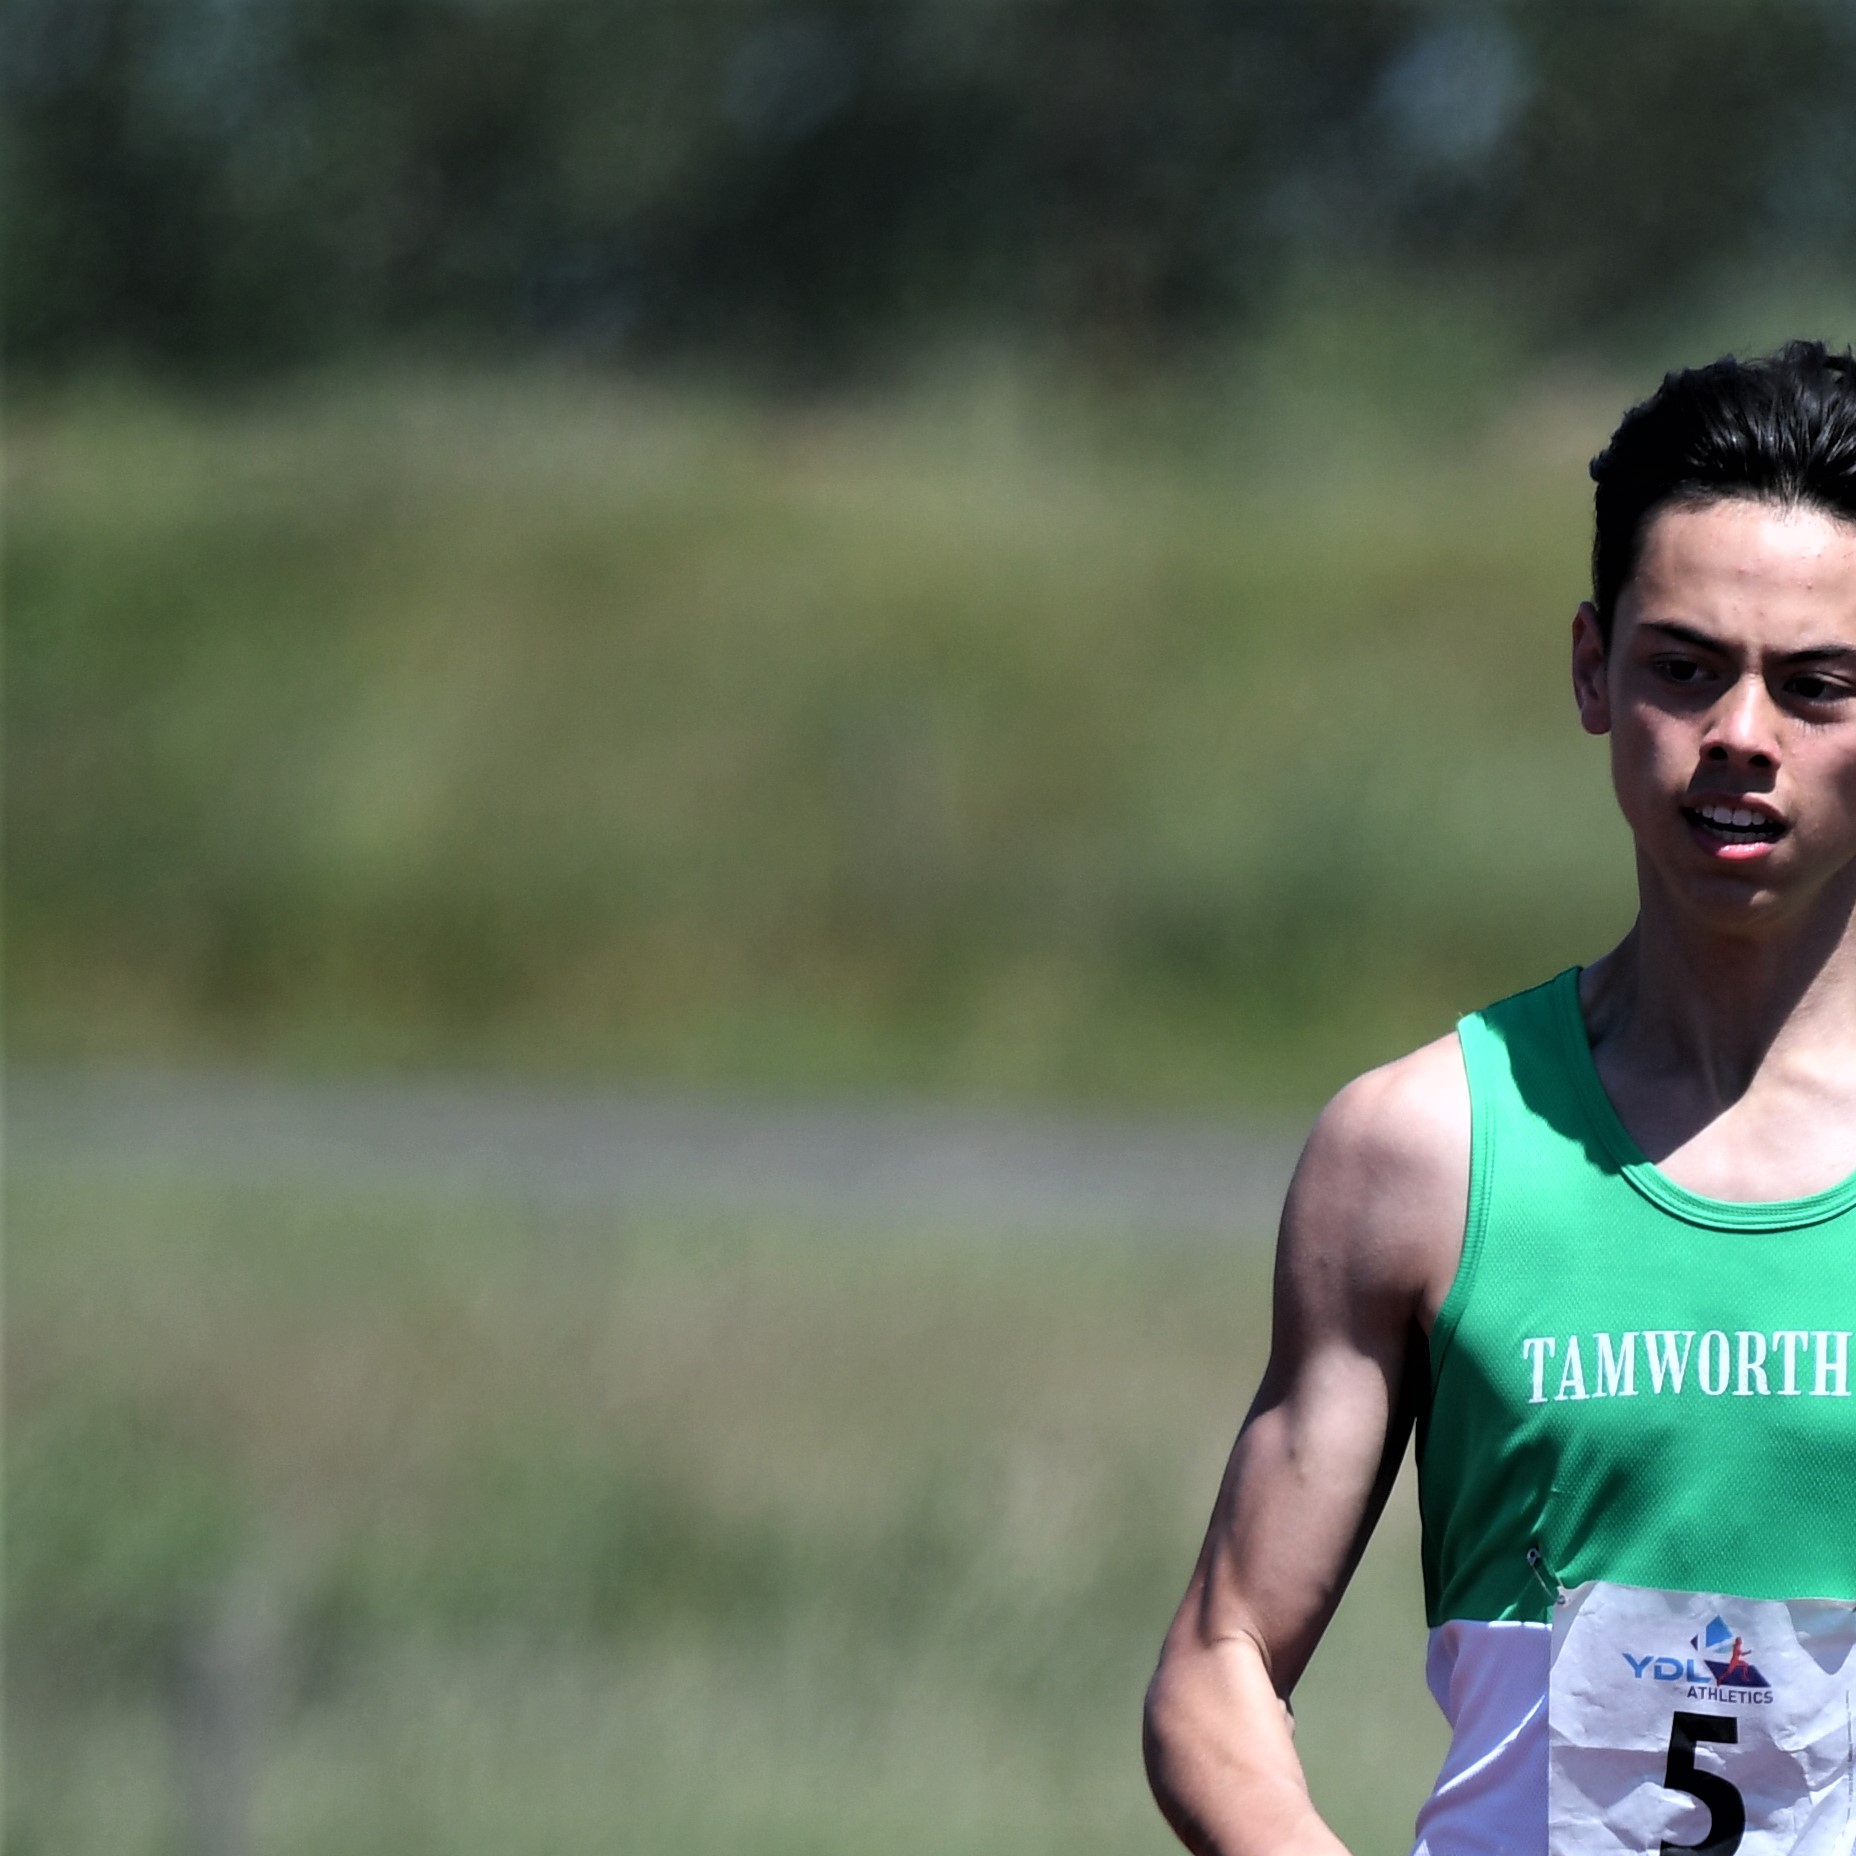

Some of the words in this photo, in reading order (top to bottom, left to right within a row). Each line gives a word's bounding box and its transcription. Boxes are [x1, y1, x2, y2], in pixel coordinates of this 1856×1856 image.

[1522, 1330, 1853, 1404] TAMWORTH
[1622, 1653, 1711, 1684] YDL
[1687, 1685, 1774, 1705] ATHLETICS
